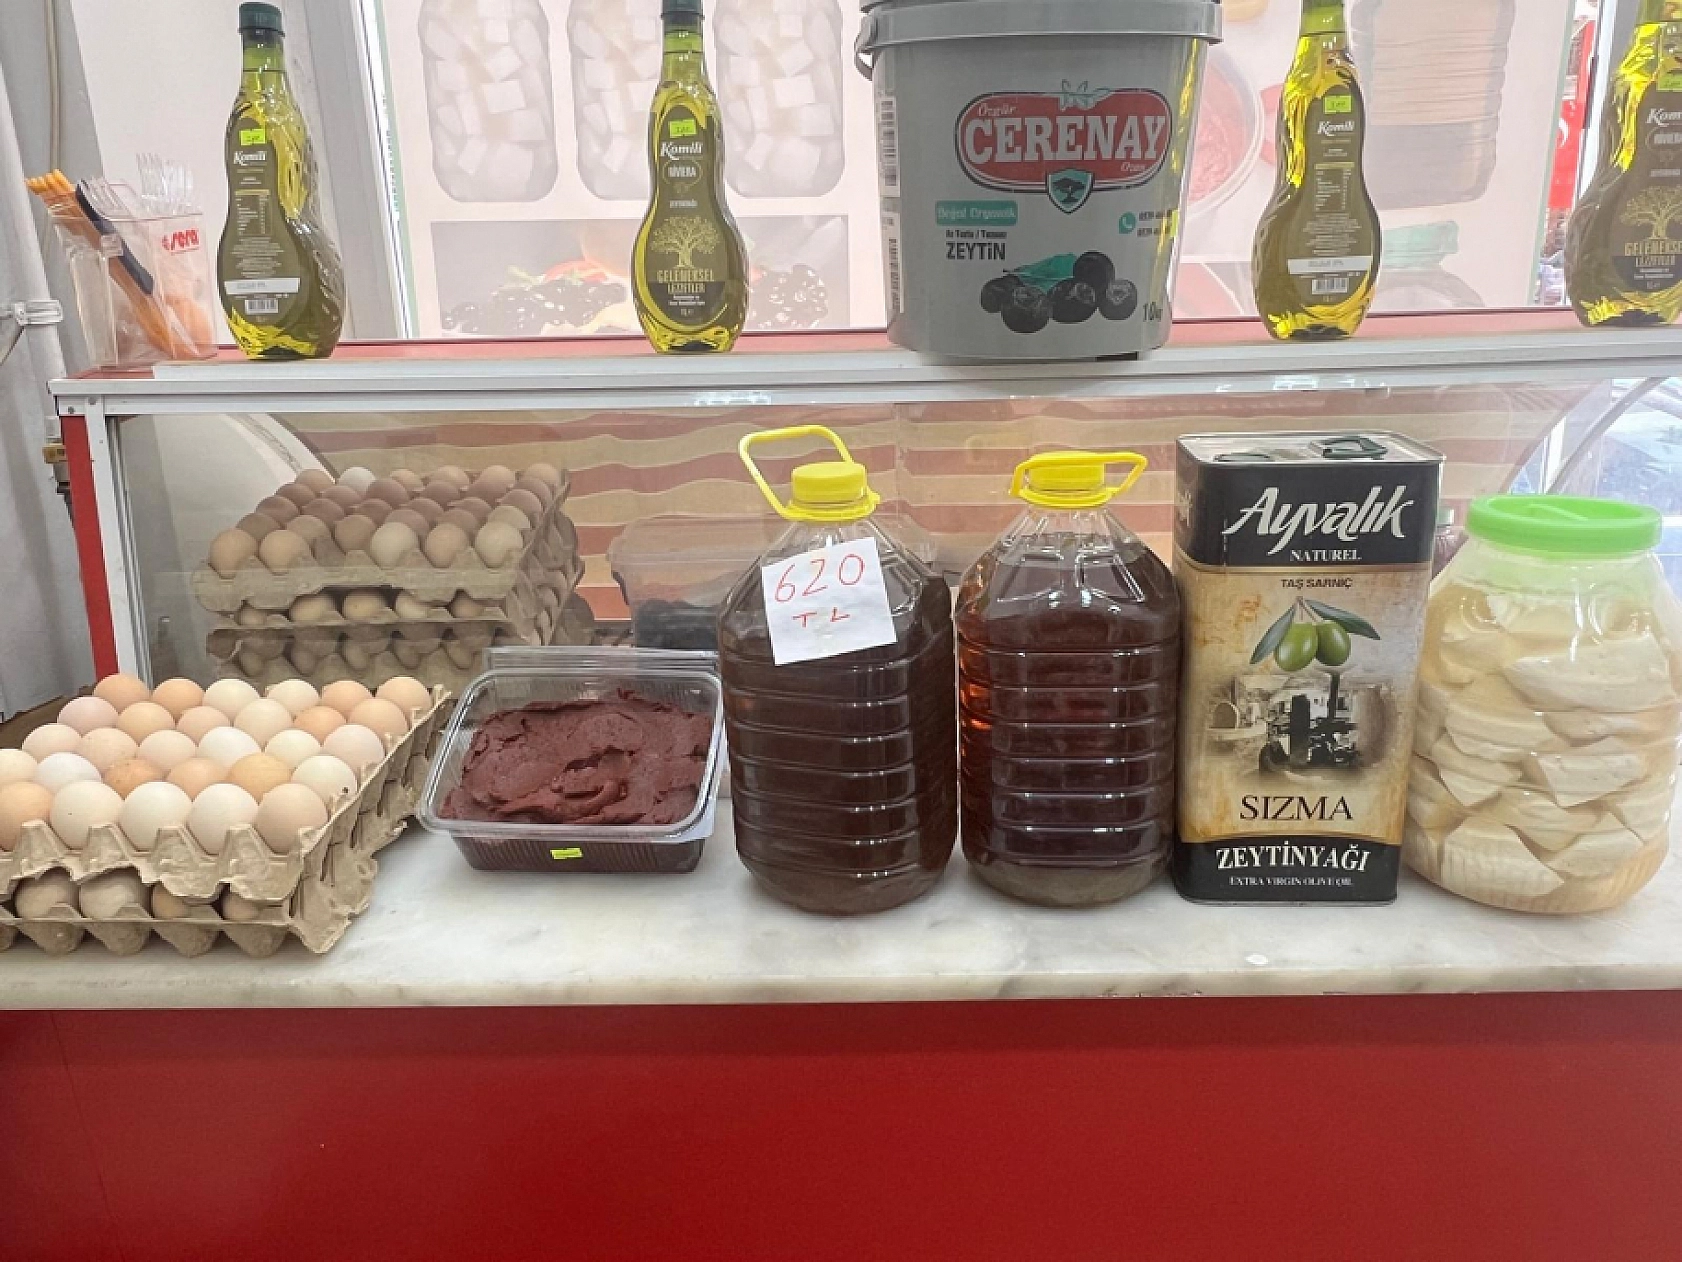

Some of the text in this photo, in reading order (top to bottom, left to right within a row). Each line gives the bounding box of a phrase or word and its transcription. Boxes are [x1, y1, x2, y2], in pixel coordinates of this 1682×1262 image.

[660, 142, 703, 161] Komili
[963, 114, 1166, 164] CERENAY
[1221, 485, 1414, 557] Ayvalık
[1289, 548, 1362, 562] NATUREL
[775, 553, 865, 603] 620
[1280, 578, 1303, 591] TAŞ
[1239, 794, 1354, 821] SIZMA
[1215, 840, 1372, 873] ZEYTİNYAĞI
